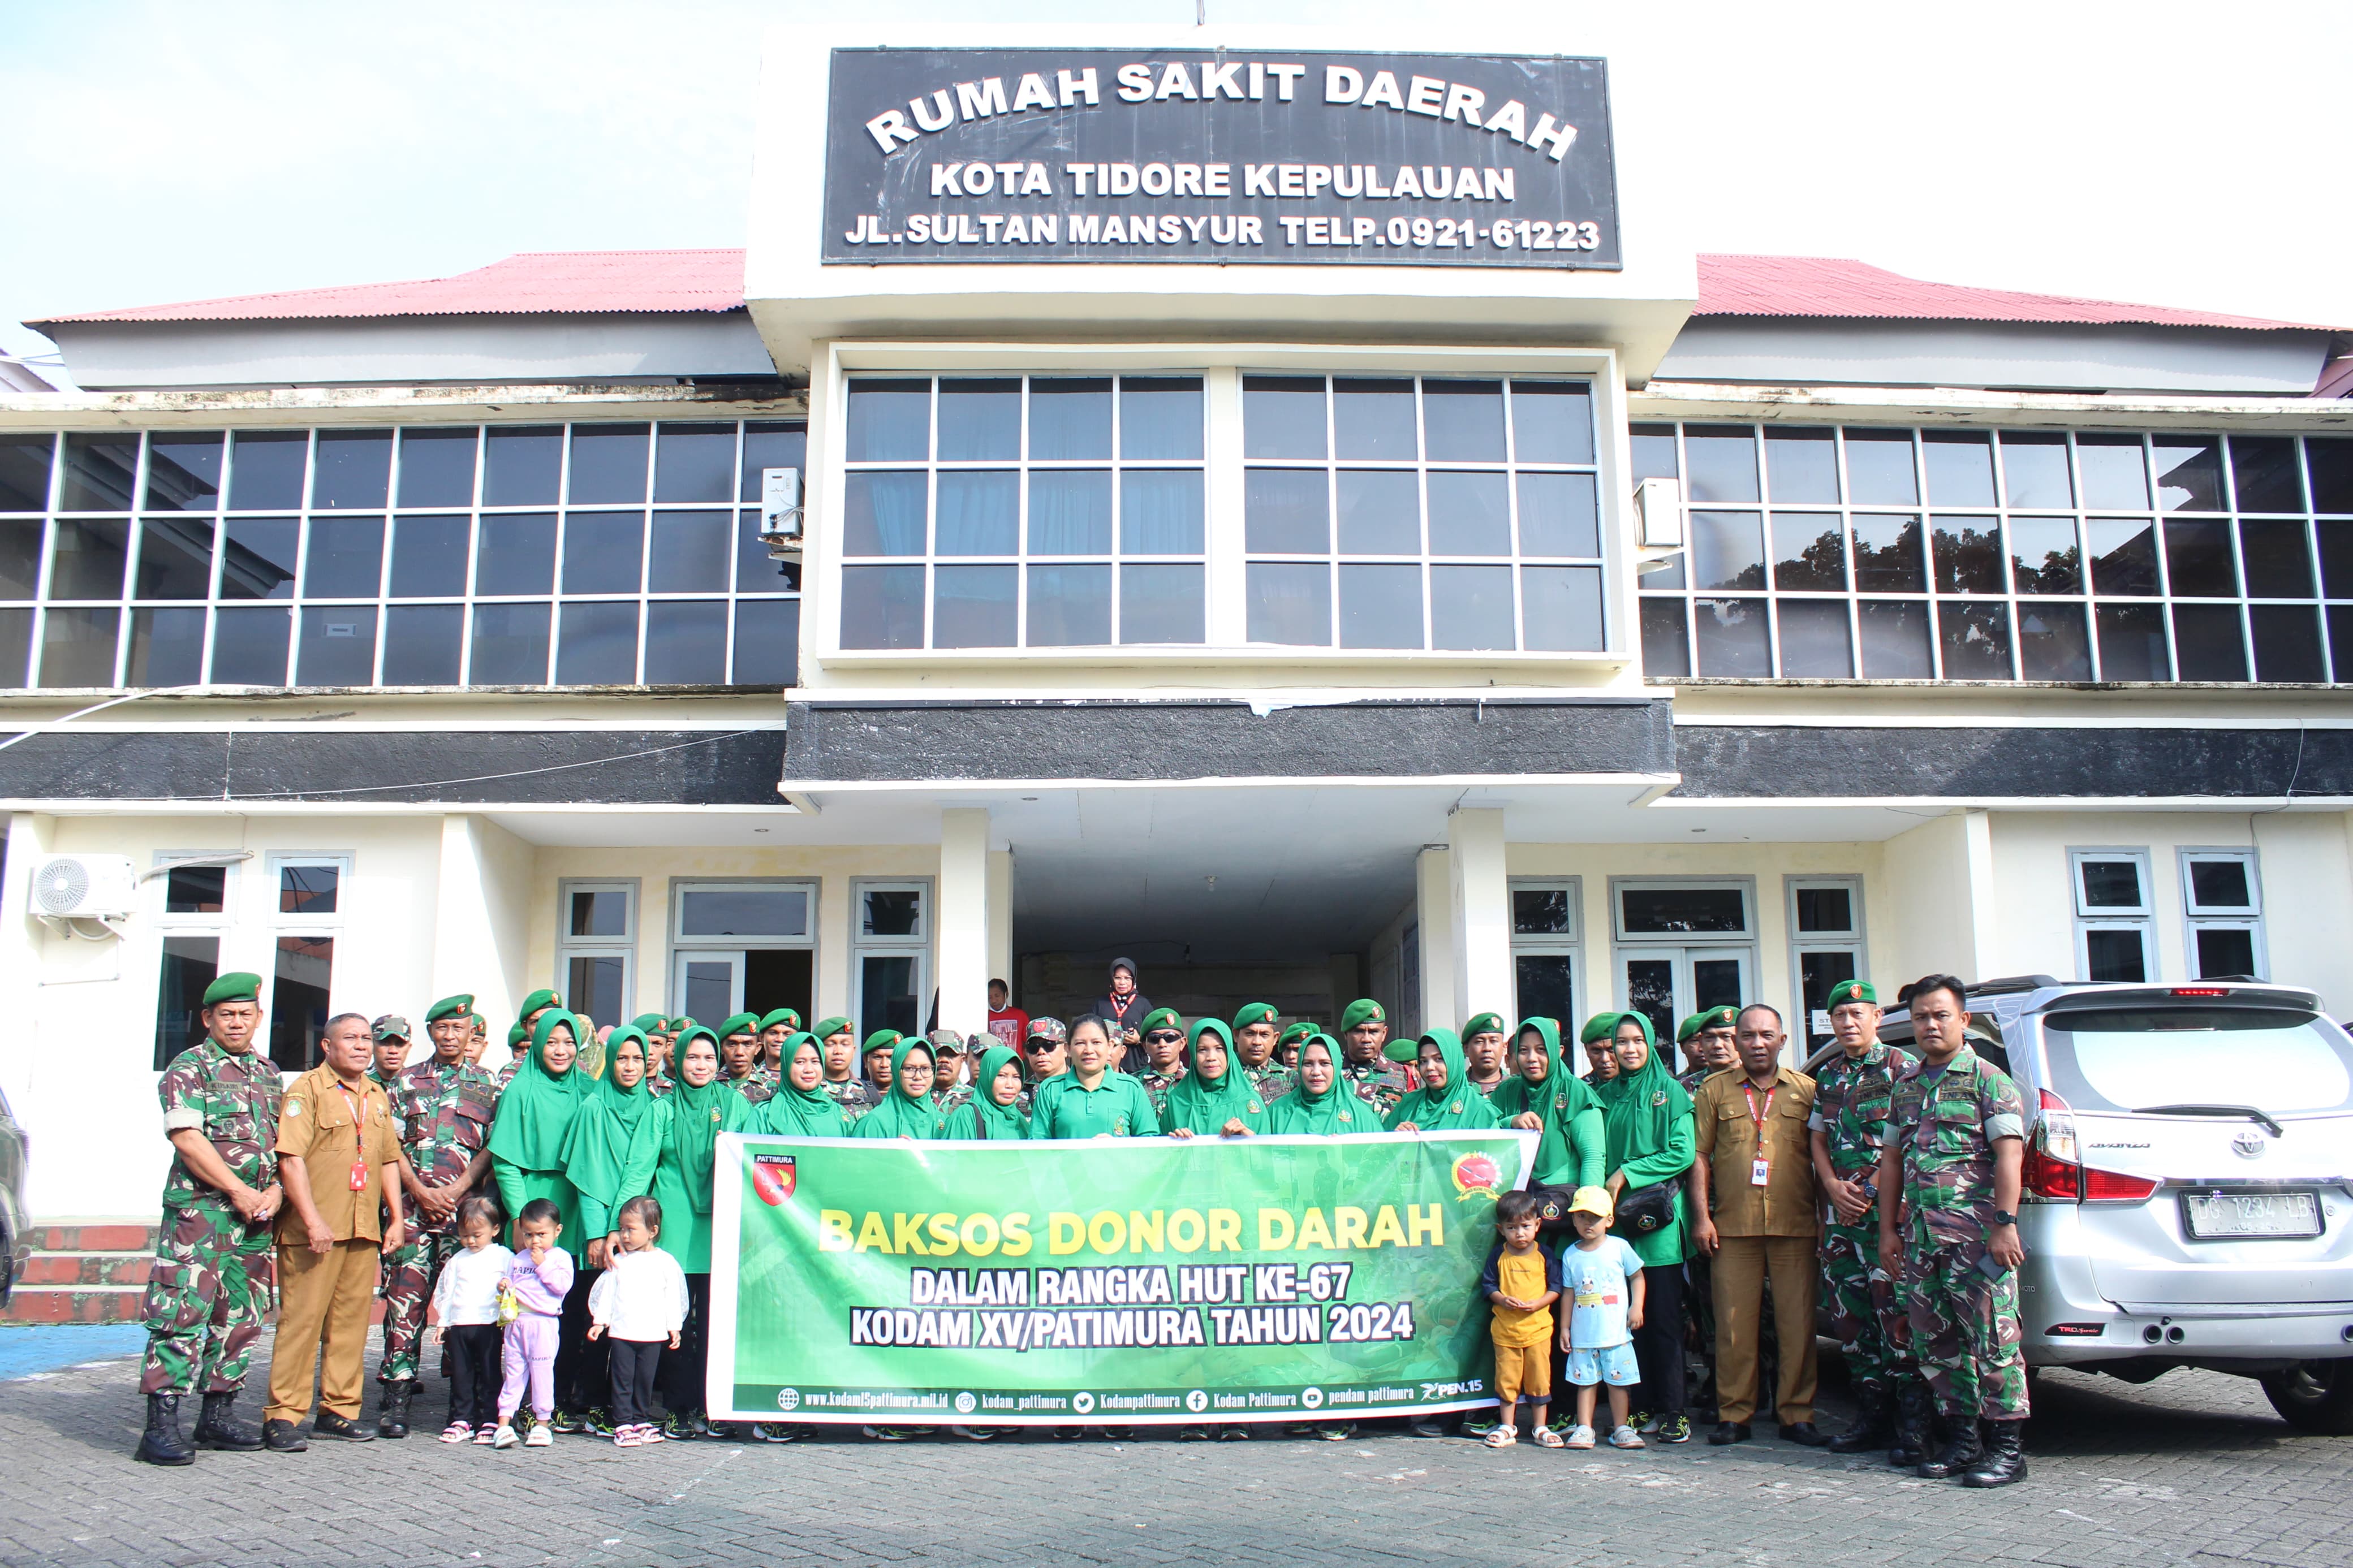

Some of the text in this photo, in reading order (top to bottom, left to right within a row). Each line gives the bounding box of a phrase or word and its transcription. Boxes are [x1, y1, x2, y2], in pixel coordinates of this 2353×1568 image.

[865, 62, 1579, 162] RUMAH SAKIT DAERAH
[929, 162, 1516, 201] KOTA TIDORE KEPULAUAN
[1068, 214, 1264, 244] MANSYUR
[756, 1155, 793, 1164] PATTIMURA
[2196, 1195, 2309, 1220] DG 1234 LB
[818, 1202, 1444, 1257] BAKSOS DONOR DARAH
[911, 1264, 1351, 1305] DALAM RANGKA HUT KE-67
[851, 1303, 1413, 1350] KODAM XV/PATIMURA TAHUN 2024
[1329, 1386, 1415, 1405] pendam pattimura
[1438, 1379, 1483, 1396] PEN.15
[805, 1391, 949, 1410] www.kodam15pattimura.mil.id
[982, 1394, 1067, 1410] kodam_pattimura
[1100, 1393, 1180, 1411] Kodampattimura
[1214, 1392, 1297, 1408] Kodam Pattimura
